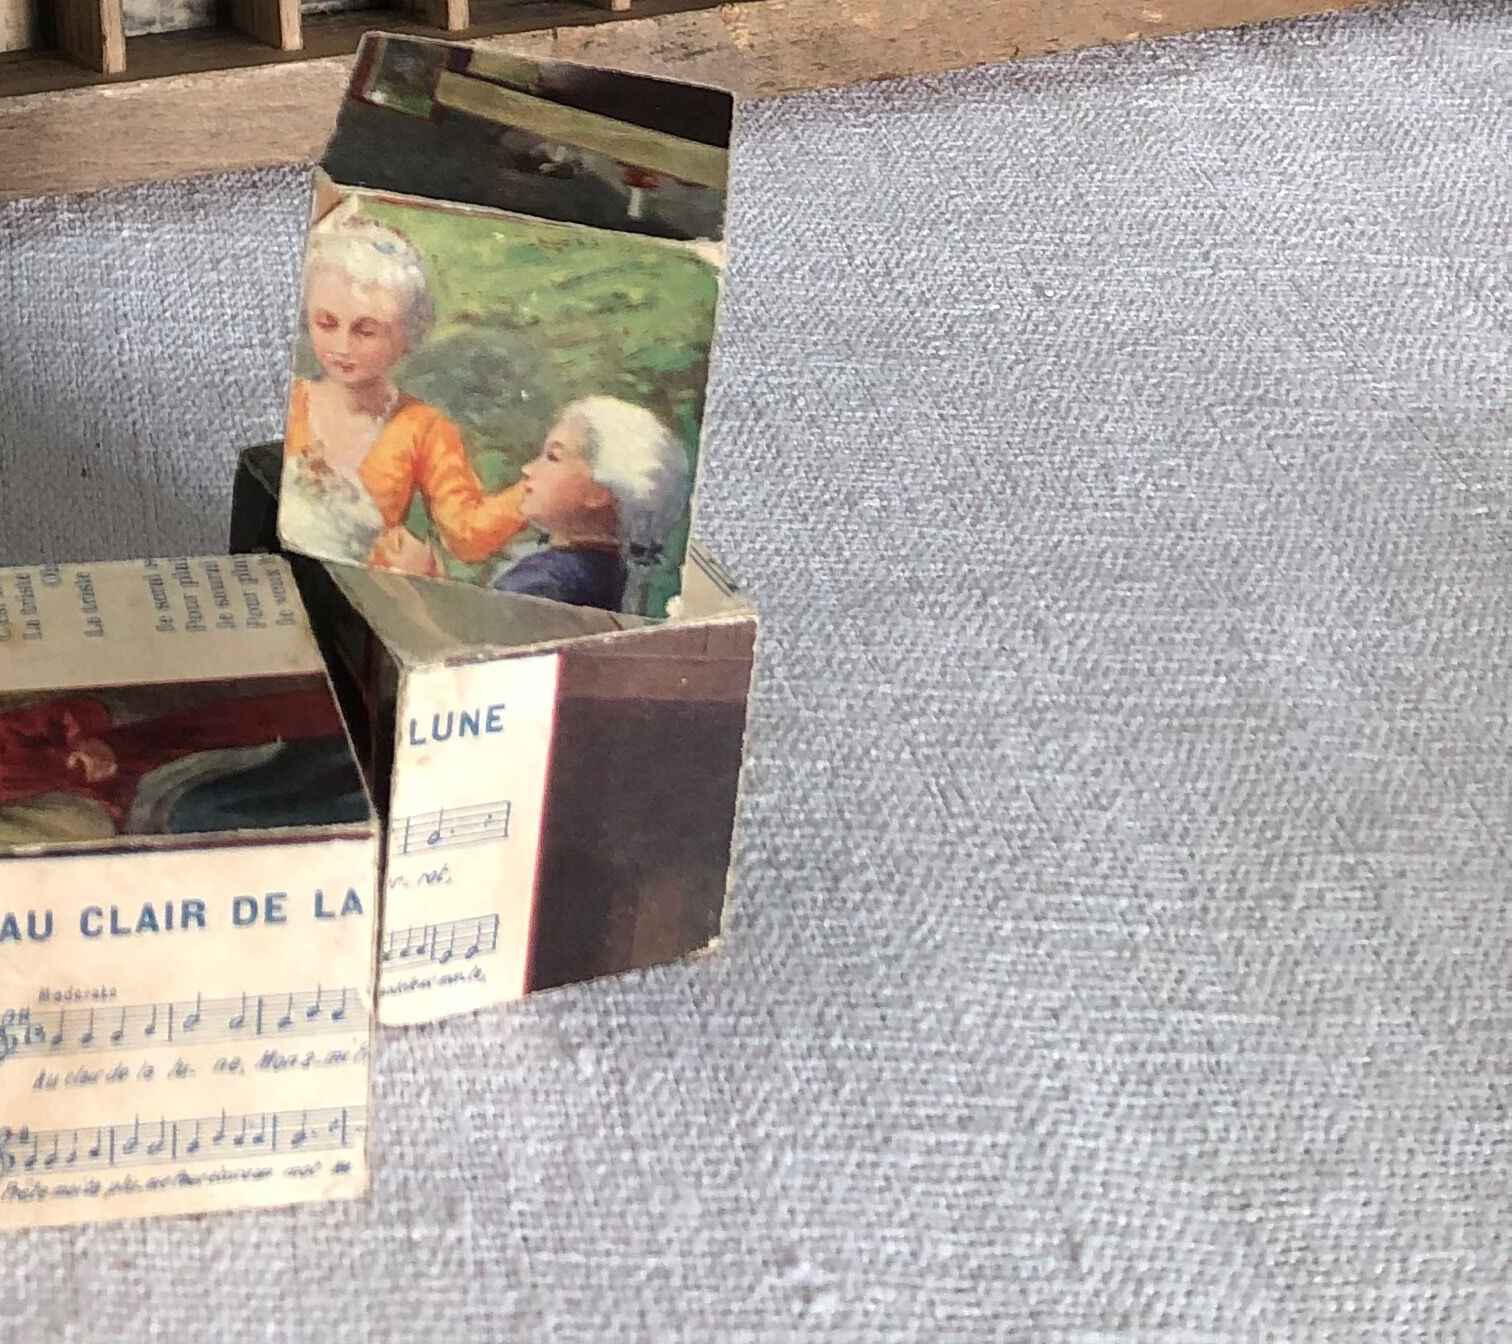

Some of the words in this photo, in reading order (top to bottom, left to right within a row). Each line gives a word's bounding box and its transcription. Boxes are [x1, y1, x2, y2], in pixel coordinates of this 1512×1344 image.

[409, 703, 506, 746] LUNE
[79, 898, 207, 938] CLAIR
[232, 891, 288, 928] DE
[313, 886, 364, 919] LA
